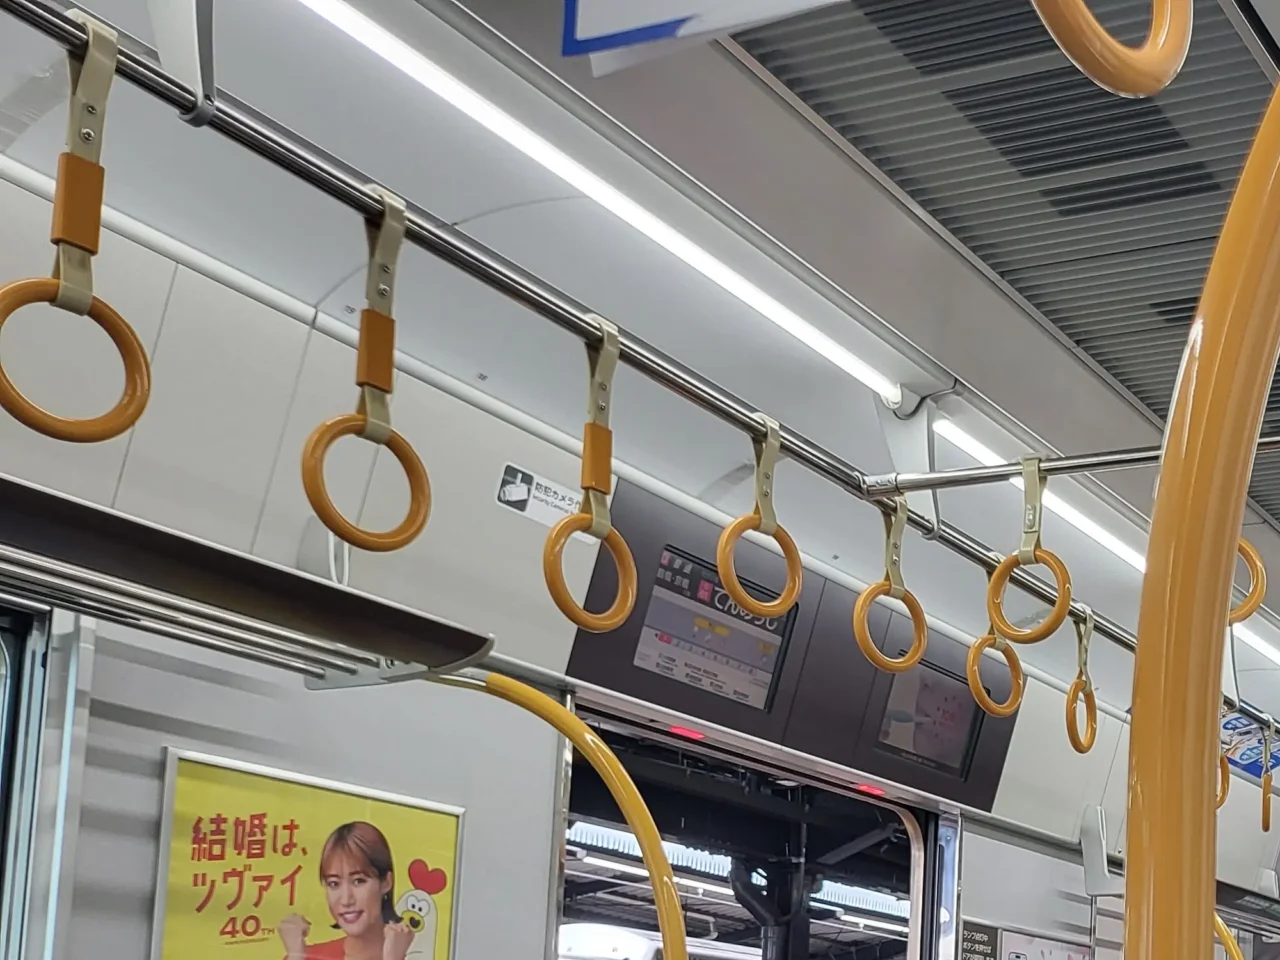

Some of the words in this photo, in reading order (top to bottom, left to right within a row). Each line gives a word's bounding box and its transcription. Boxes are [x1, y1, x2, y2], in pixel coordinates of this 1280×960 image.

[190, 812, 308, 862] 結婚は、
[192, 864, 303, 914] ツヴァイ
